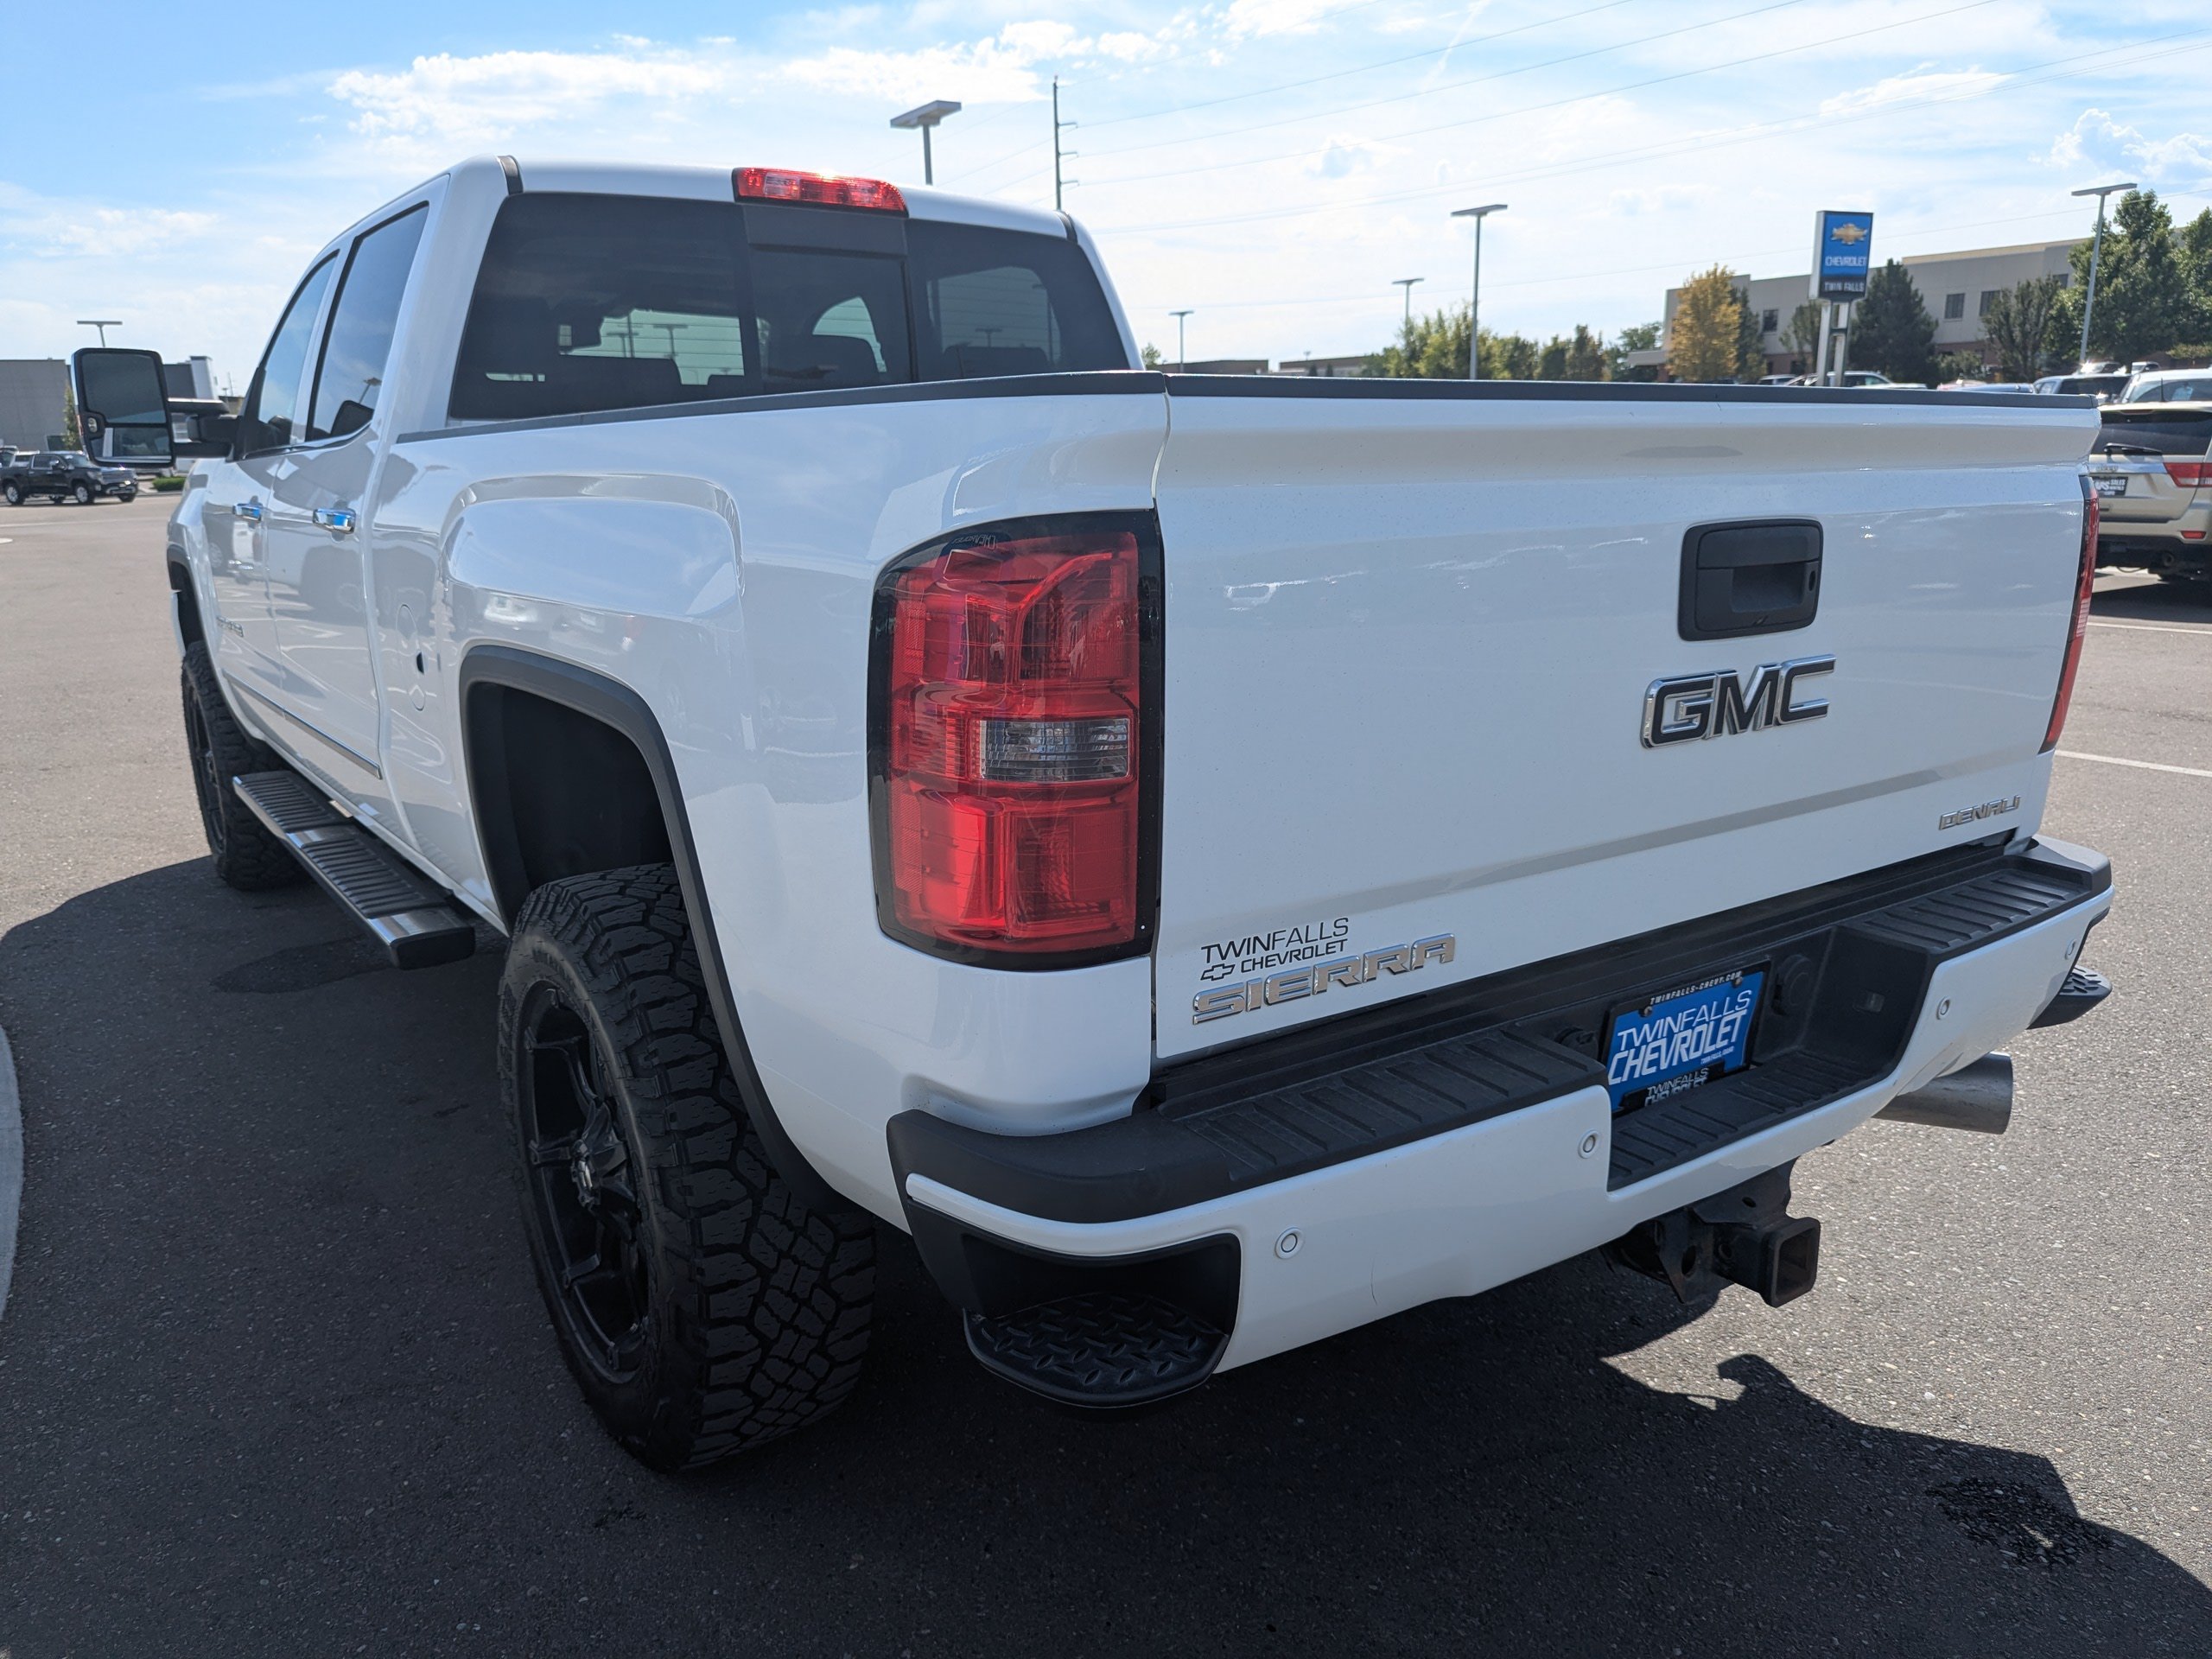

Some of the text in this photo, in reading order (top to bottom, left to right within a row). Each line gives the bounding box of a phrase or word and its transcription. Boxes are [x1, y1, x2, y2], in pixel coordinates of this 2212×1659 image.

[1825, 256, 1866, 267] CHEVROLET
[1824, 281, 1865, 292] TWIN FALLS
[1640, 653, 1837, 749] GMC
[1938, 794, 2022, 830] DENALI
[1201, 918, 1349, 963] TWINFALLS
[1241, 939, 1348, 973] CHEVROLET
[1192, 933, 1456, 1025] SIERRA
[1618, 989, 1752, 1052] TWINFALLS
[1608, 1009, 1748, 1086] CHEVROLET
[1647, 1067, 1709, 1096] TWINFALLS
